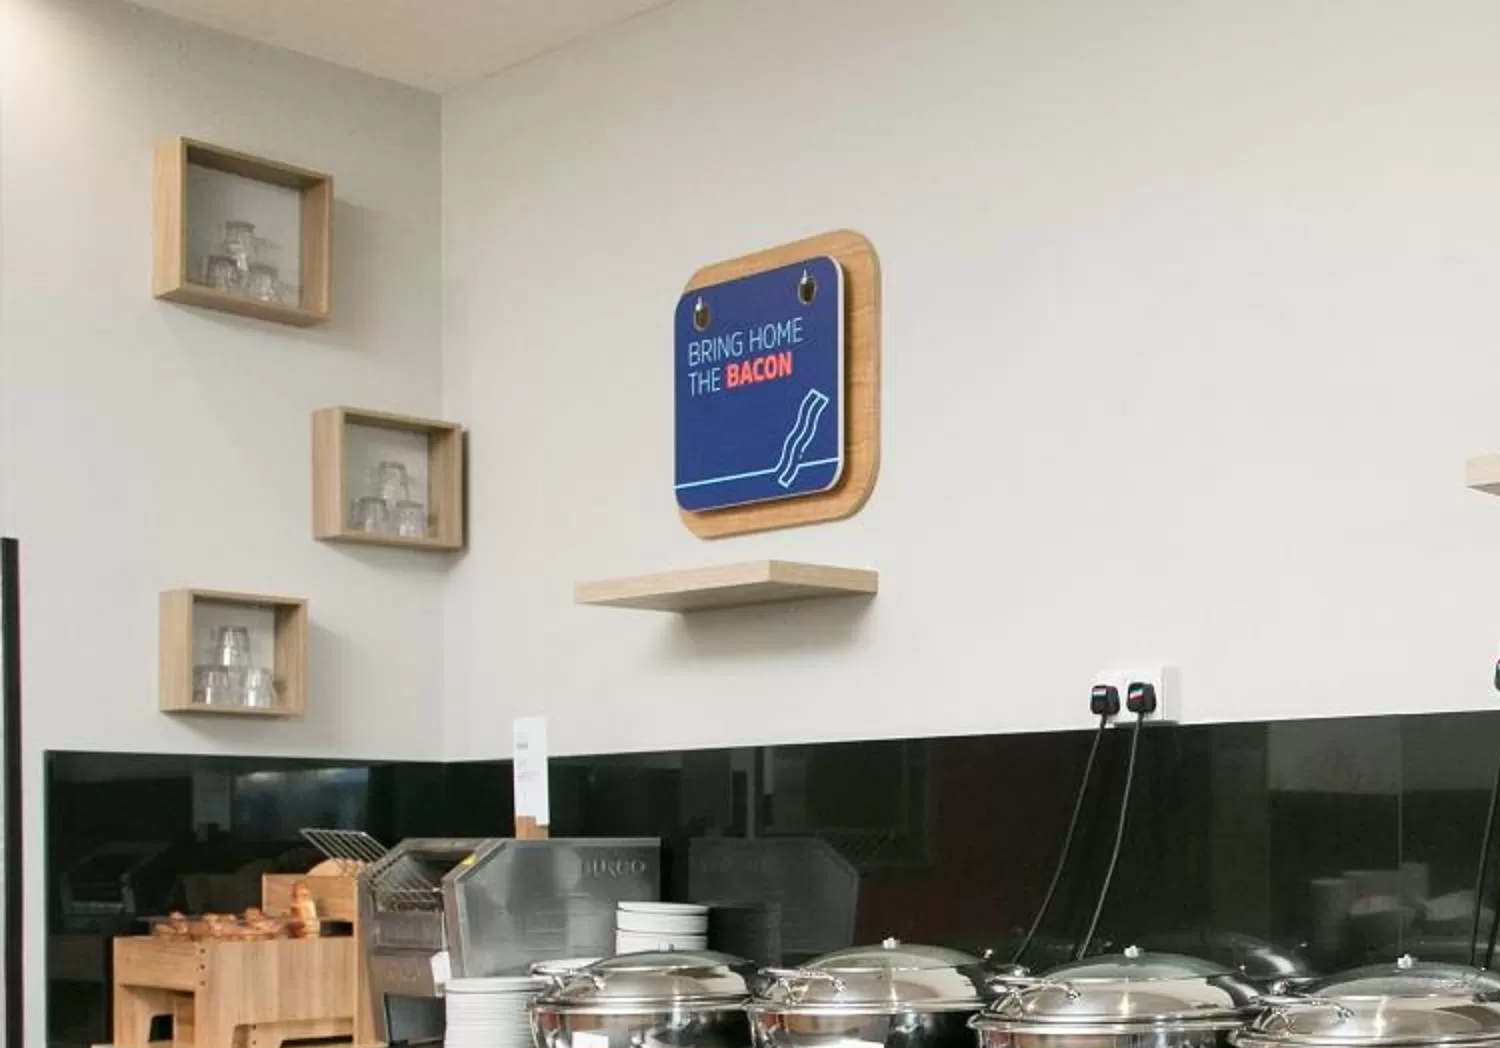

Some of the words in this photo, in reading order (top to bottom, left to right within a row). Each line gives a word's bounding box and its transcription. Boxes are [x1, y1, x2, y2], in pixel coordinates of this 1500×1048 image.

[688, 331, 743, 367] BRING
[750, 317, 804, 350] HOME
[688, 368, 721, 396] THE
[726, 352, 792, 388] BACON
